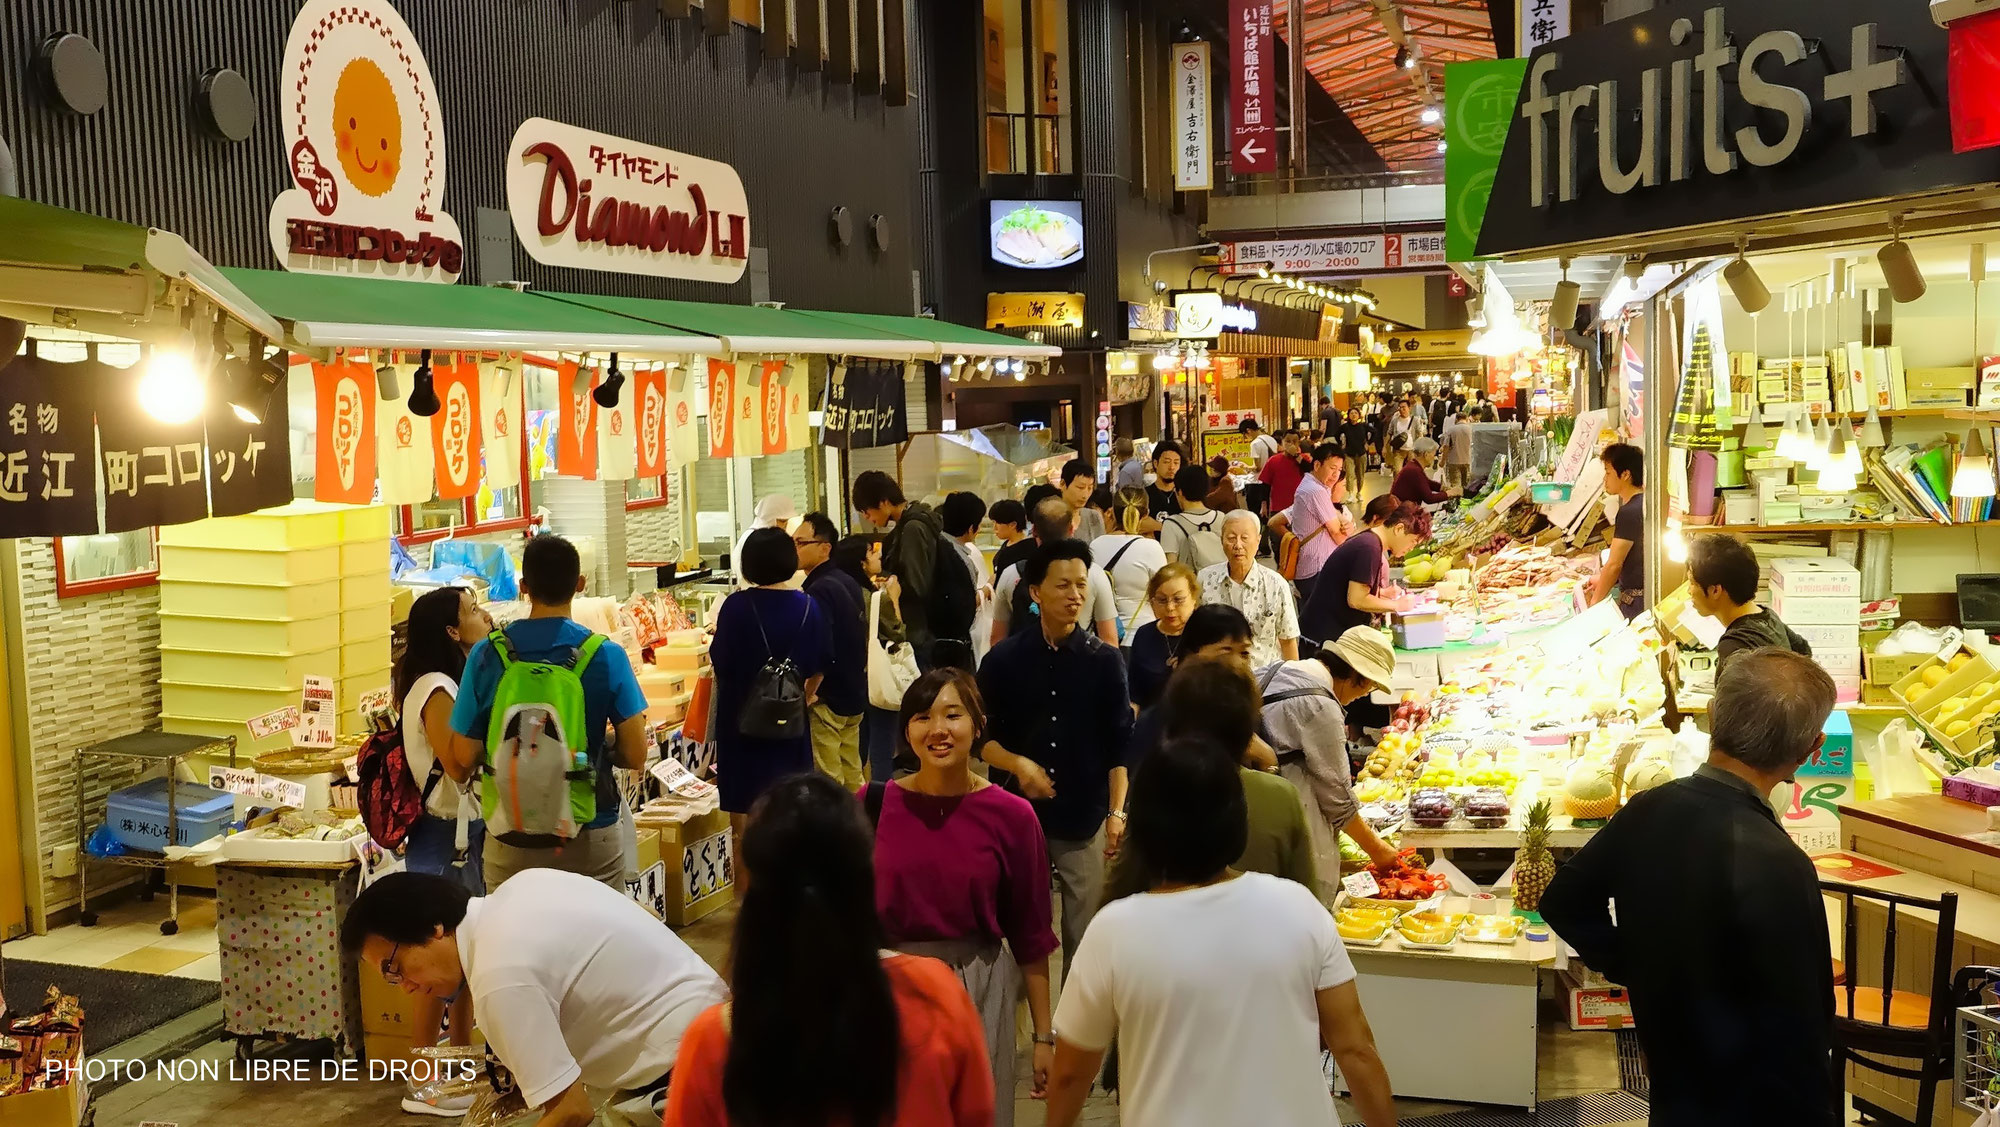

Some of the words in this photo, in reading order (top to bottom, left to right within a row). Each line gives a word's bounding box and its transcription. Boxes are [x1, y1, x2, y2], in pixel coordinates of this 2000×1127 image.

[1260, 5, 1270, 36] 近江町
[1243, 8, 1260, 96] いちば館広場
[1235, 126, 1271, 135] エレベーター
[295, 147, 334, 208] 金沢
[589, 144, 679, 188] ダイヤモンド
[521, 141, 708, 257] Diamond
[1241, 240, 1376, 259] 食料品・ドラッグ・グルメ広場のフロア
[8, 402, 59, 435] 名物
[339, 395, 352, 478] コロッケ
[449, 398, 464, 475] コロッケ
[647, 395, 656, 458] コロッケ
[825, 403, 895, 434] 近江町コロッケ
